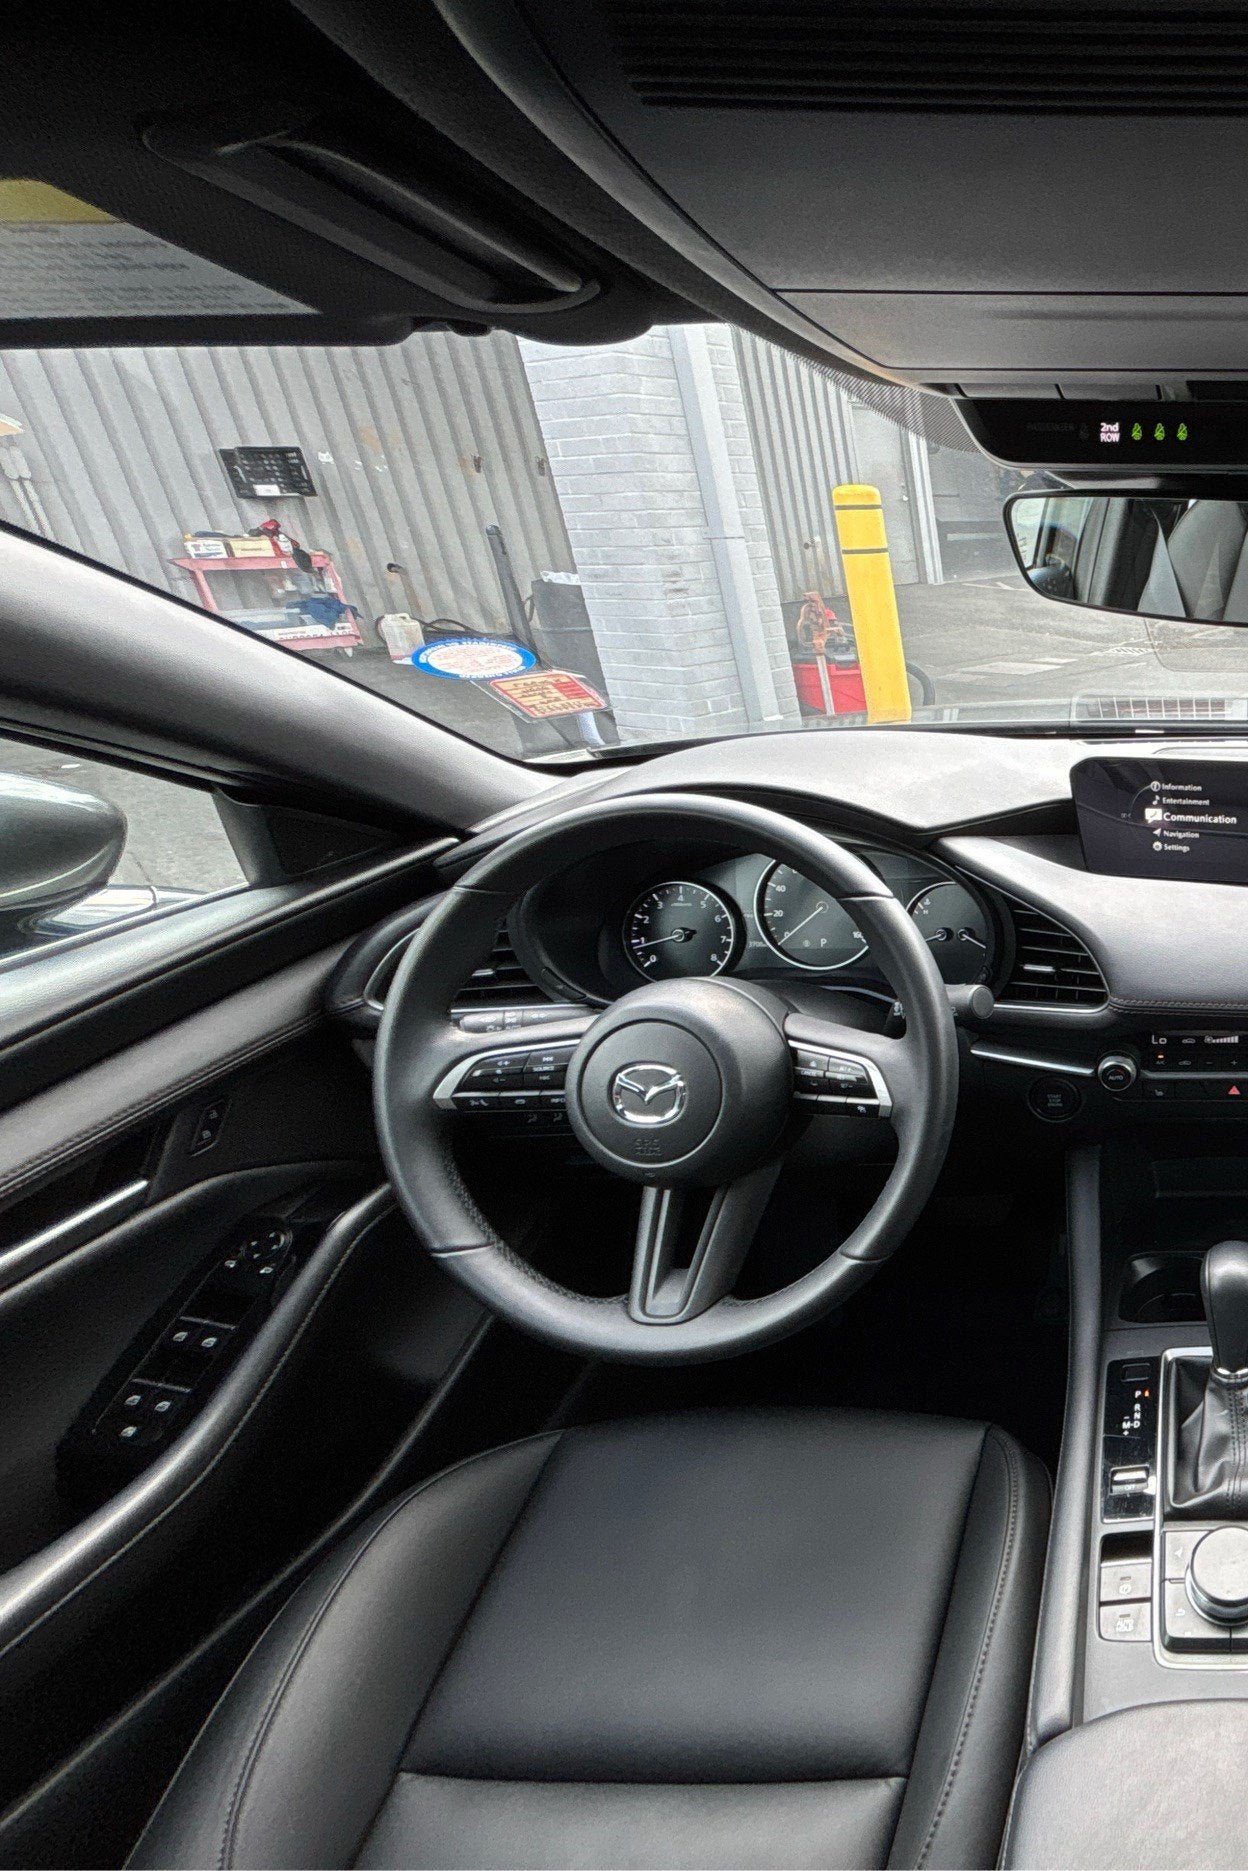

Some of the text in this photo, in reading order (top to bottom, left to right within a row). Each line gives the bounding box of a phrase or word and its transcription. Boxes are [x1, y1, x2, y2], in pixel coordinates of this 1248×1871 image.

[1100, 422, 1120, 432] 2nd
[1100, 432, 1121, 443] ROW
[1162, 783, 1203, 792] Information
[1162, 797, 1210, 806] Entertainment
[1163, 812, 1238, 824] Communication
[1163, 830, 1200, 839] Navigation
[1163, 843, 1190, 853] Settings
[775, 885, 787, 893] 40
[677, 894, 684, 902] 4
[657, 901, 664, 910] 3
[700, 900, 707, 909] 5
[773, 909, 784, 918] 20
[642, 915, 650, 924] 2
[714, 914, 721, 923] 6
[640, 936, 645, 945] 1
[720, 935, 727, 944] 7
[820, 938, 827, 948] P
[649, 954, 657, 963] 0
[710, 953, 718, 962] 8
[1151, 1034, 1167, 1045] Lo
[1134, 1390, 1141, 1398] P
[1134, 1403, 1141, 1411] R
[1133, 1411, 1141, 1420] N
[1122, 1420, 1141, 1430] M D
